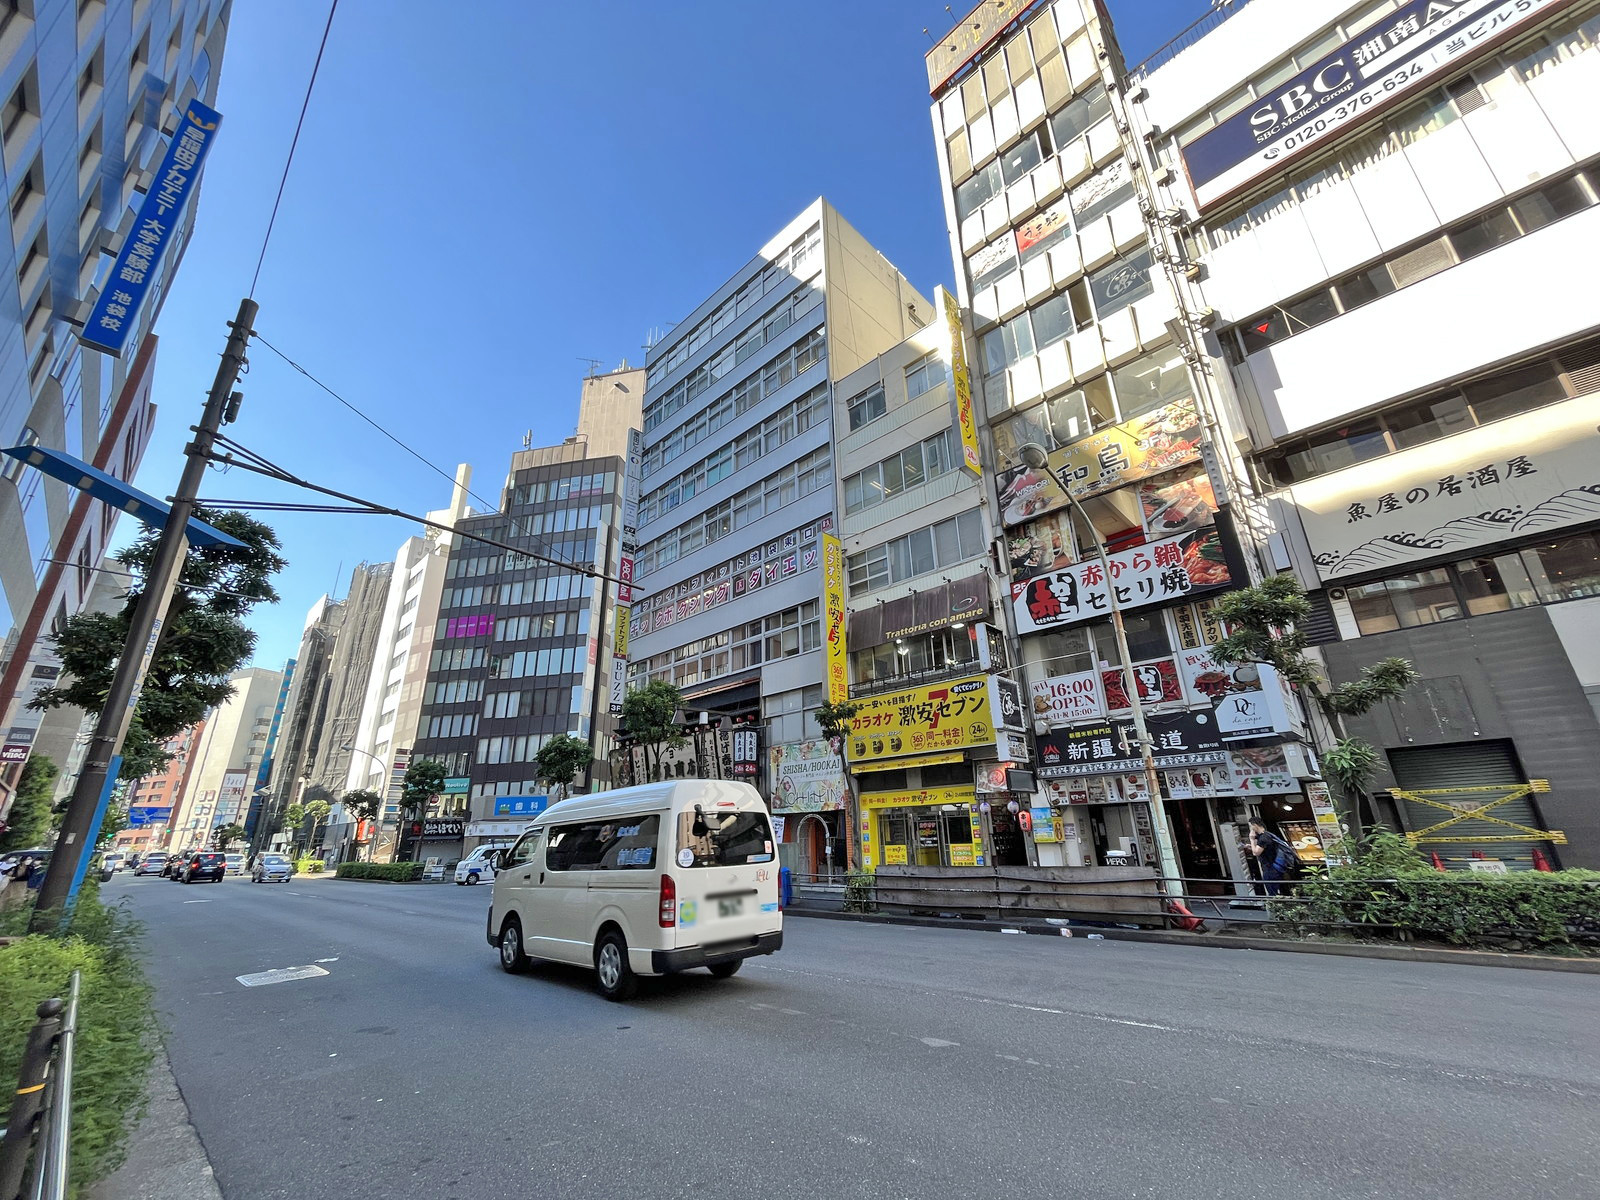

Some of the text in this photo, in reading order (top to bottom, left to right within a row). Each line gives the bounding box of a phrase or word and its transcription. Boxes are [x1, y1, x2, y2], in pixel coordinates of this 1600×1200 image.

[1352, 0, 1460, 66] 湘南A
[1250, 59, 1351, 137] SBC
[1256, 81, 1354, 144] SBC Medical Group
[1284, 62, 1424, 150] 0120-376-634
[100, 126, 207, 332] 早稲田アカデミー 大学受験部 池袋校
[1347, 455, 1538, 524] 魚屋の居酒屋
[620, 561, 632, 579] ABC
[827, 543, 837, 589] カラオケ
[1079, 541, 1184, 588] 赤から鍋
[1085, 568, 1192, 610] セセリ焼
[829, 592, 841, 657] 激安セブン
[886, 608, 984, 640] Trattoria con amare
[613, 661, 623, 705] BUZZ
[1049, 678, 1094, 698] 16:00
[610, 704, 622, 712] 3F
[898, 695, 985, 727] 激安セブン
[1052, 694, 1097, 711] OPEN
[852, 712, 894, 731] カラオケ
[926, 727, 965, 742] 同一料金!
[912, 735, 924, 744] 365
[926, 737, 964, 748] だから安心!
[2, 752, 27, 760] VELOCE
[514, 801, 539, 812] 歯科
[438, 823, 461, 834] ほてい
